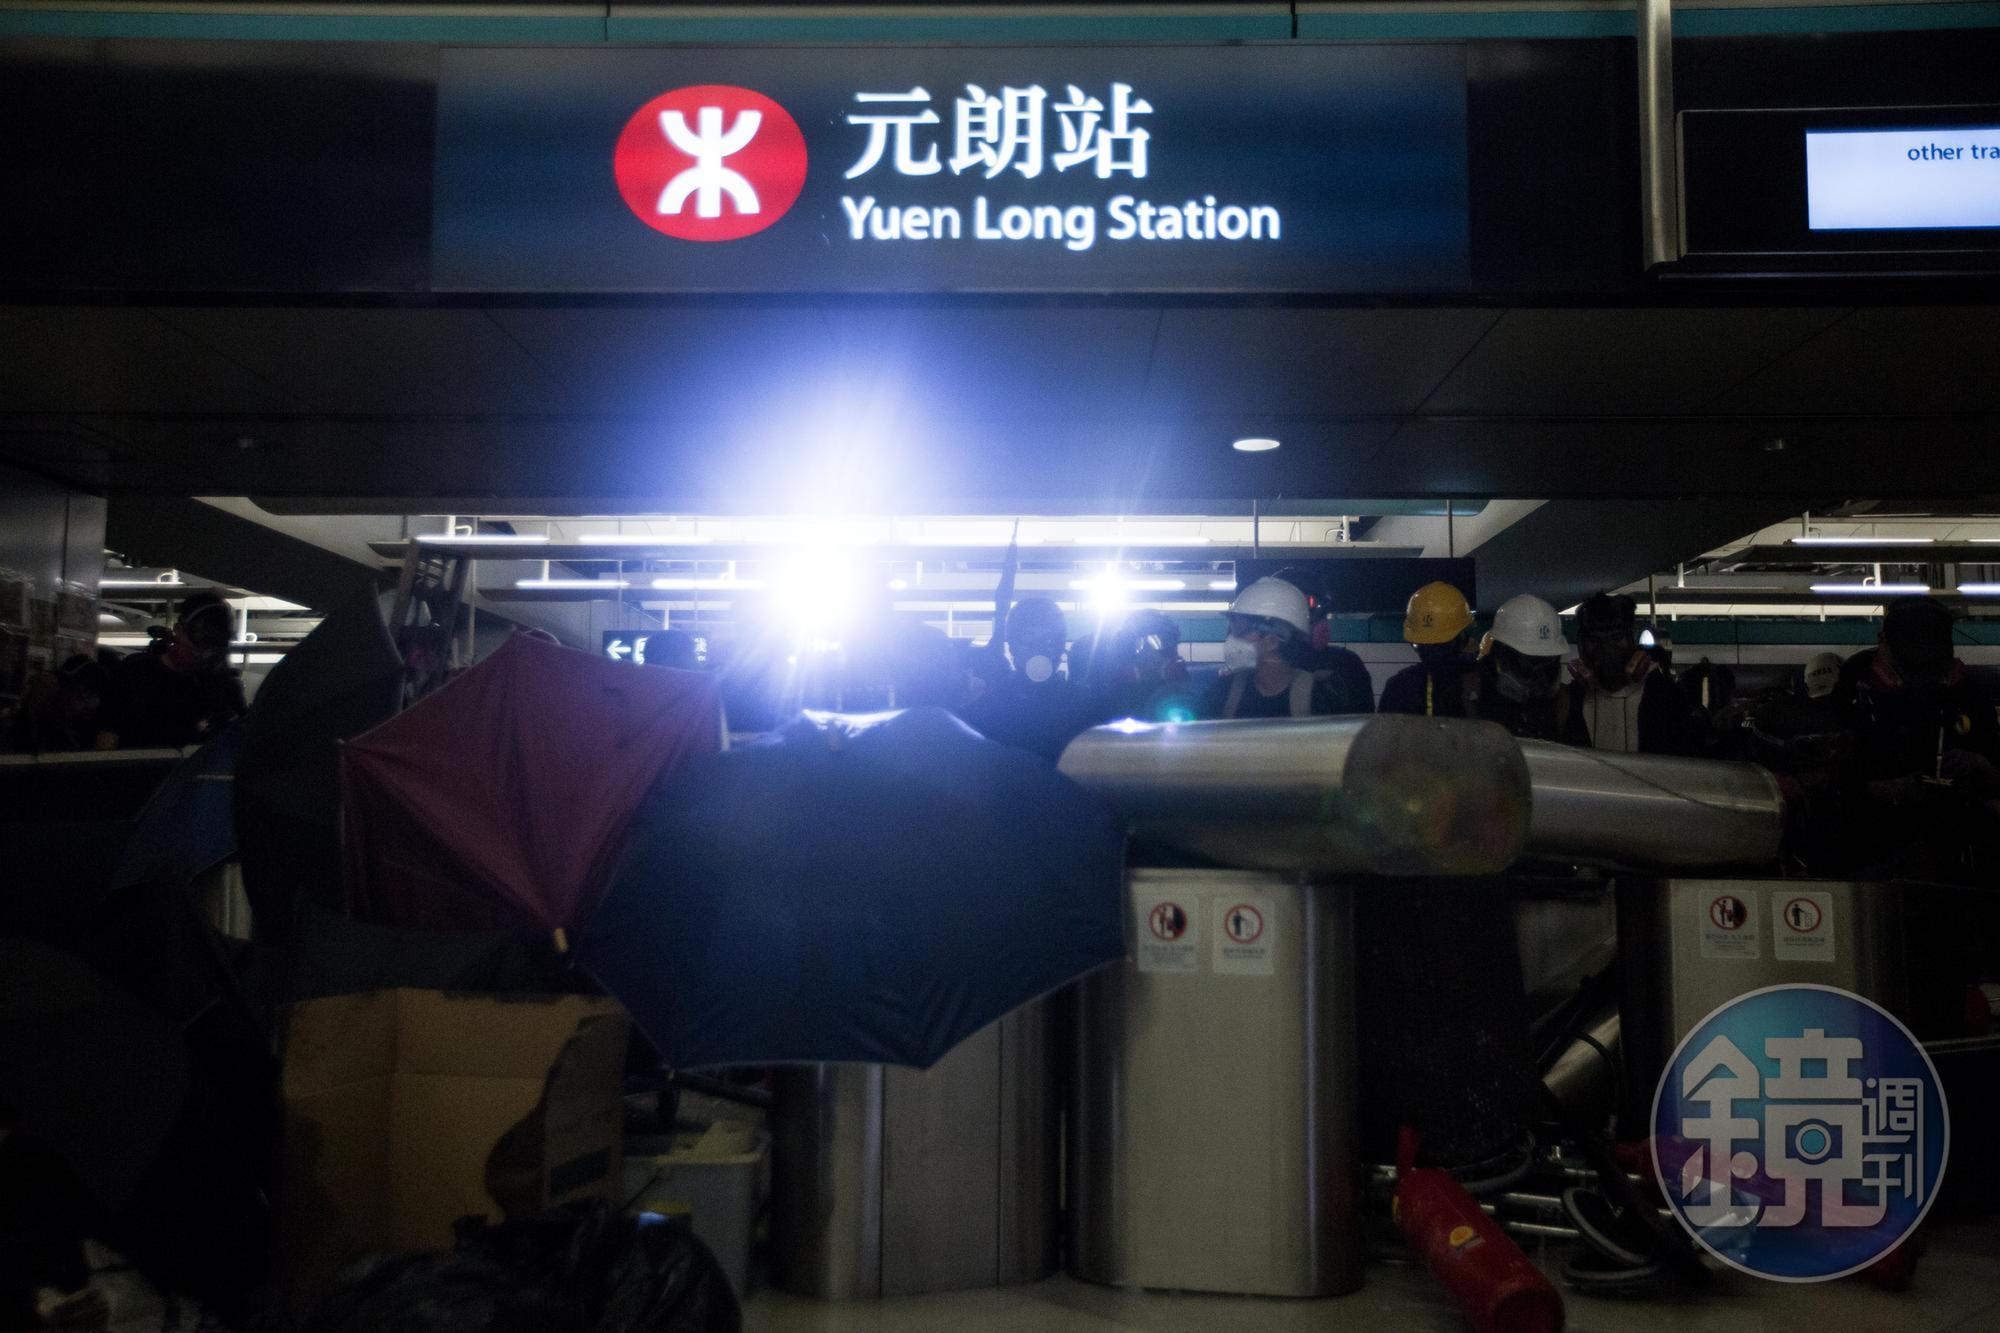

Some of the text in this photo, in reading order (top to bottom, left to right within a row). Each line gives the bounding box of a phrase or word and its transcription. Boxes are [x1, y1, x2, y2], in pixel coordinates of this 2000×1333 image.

[843, 82, 1154, 181] 元朗站
[1907, 143, 1964, 161] other
[841, 194, 1281, 252] Yuen Long Station
